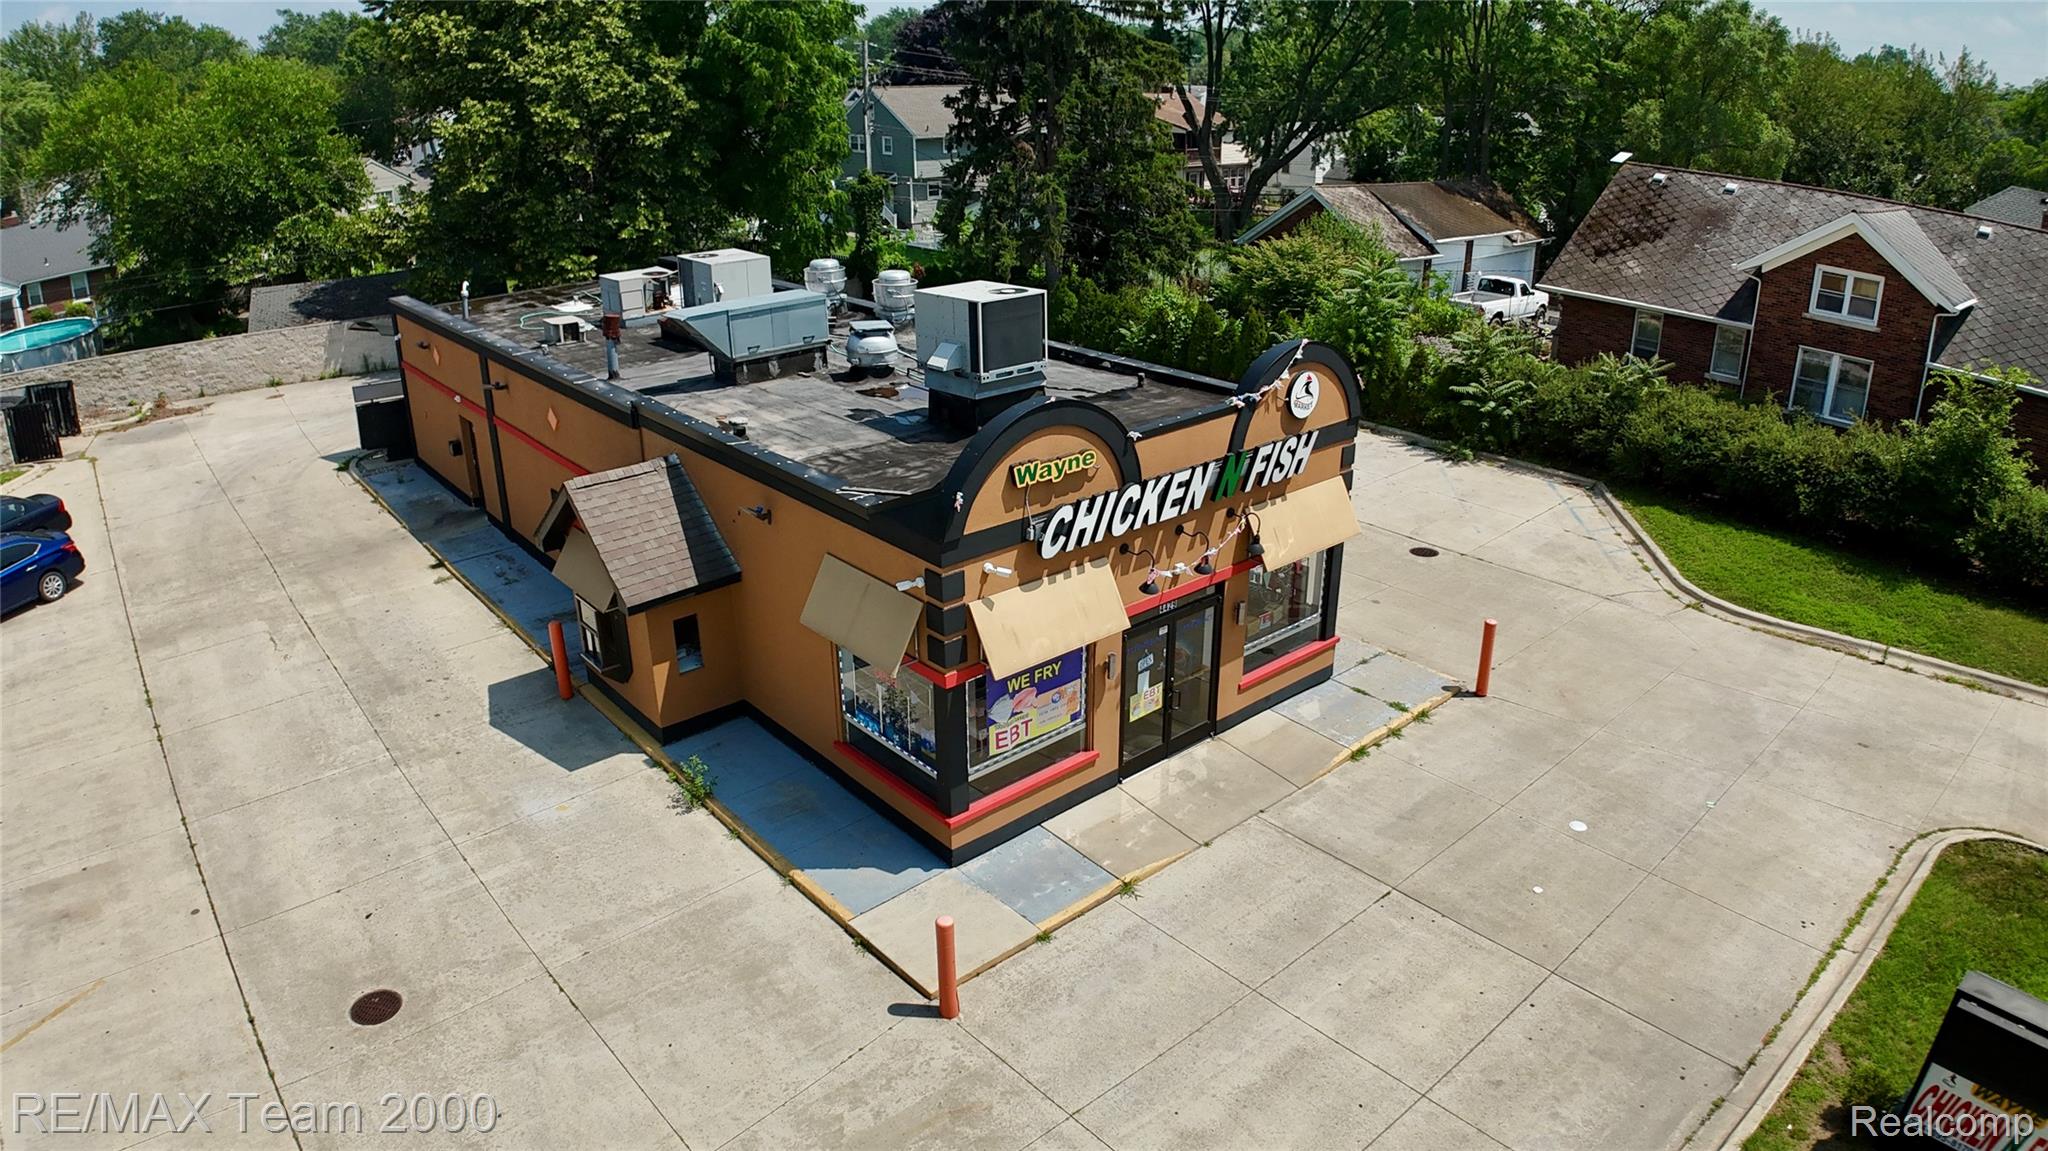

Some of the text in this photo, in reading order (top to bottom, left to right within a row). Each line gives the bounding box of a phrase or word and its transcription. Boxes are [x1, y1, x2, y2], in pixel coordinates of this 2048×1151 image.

[1013, 449, 1098, 488] Wayne
[1040, 430, 1319, 560] CHICKEN N FISH
[1007, 660, 1062, 693] WE FRY
[1143, 684, 1161, 699] EBT
[995, 718, 1033, 750] EBT
